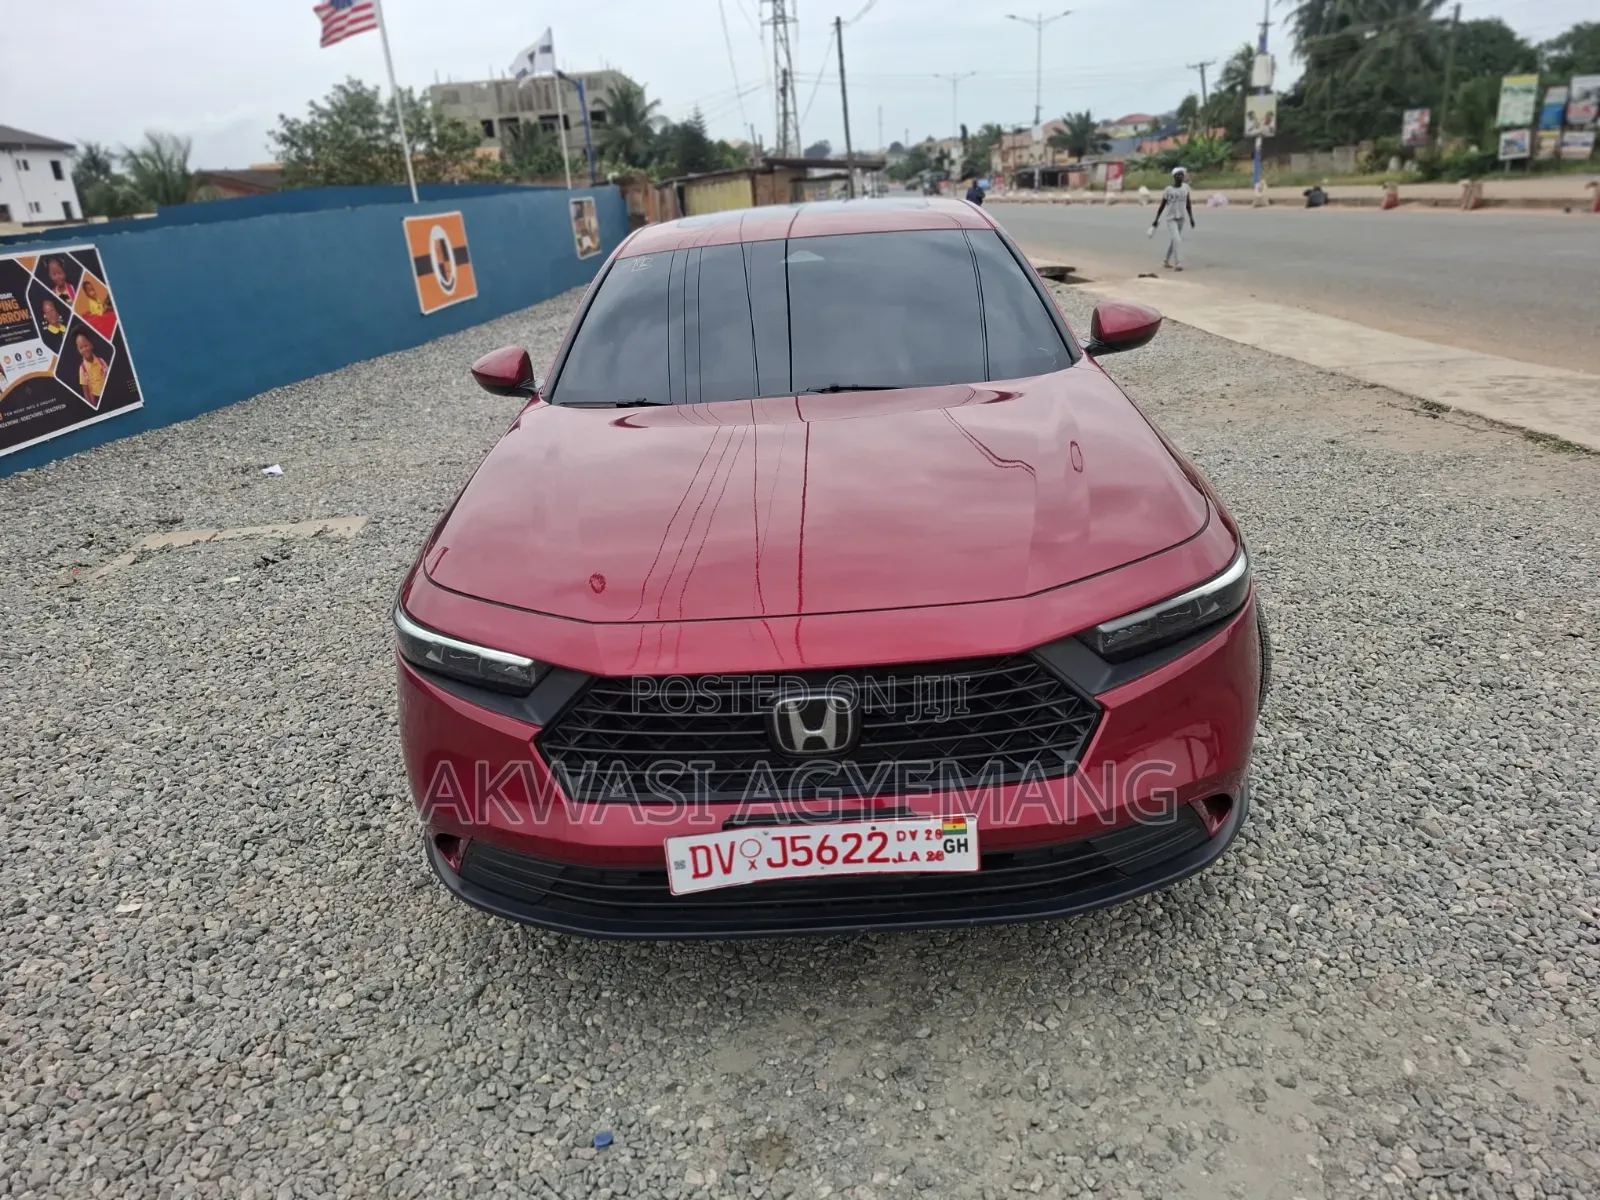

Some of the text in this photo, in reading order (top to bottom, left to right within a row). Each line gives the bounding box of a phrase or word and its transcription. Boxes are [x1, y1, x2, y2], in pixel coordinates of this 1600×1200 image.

[896, 829, 918, 842] DV
[943, 837, 969, 854] GH
[688, 831, 891, 880] DV J5622
